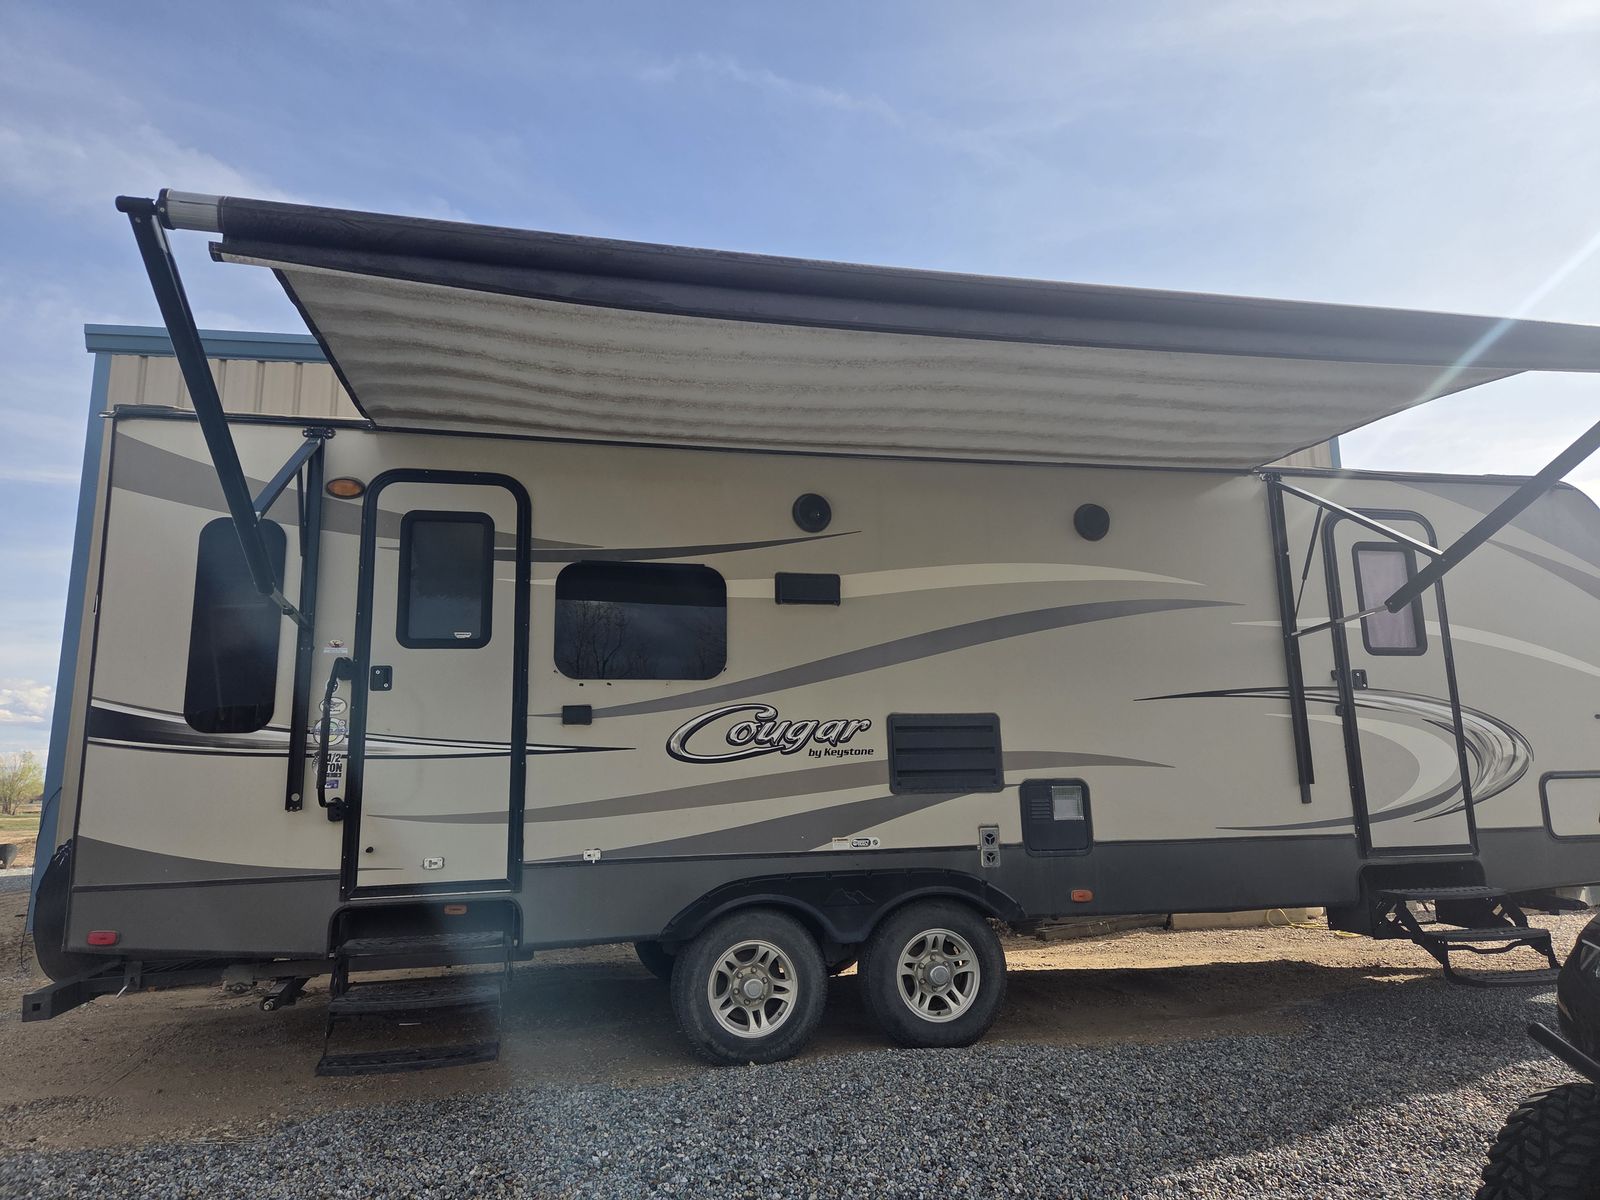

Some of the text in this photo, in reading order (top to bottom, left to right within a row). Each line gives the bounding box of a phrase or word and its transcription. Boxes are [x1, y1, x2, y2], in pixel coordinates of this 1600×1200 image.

[666, 703, 872, 764] Cougar
[808, 748, 874, 759] by Keystone
